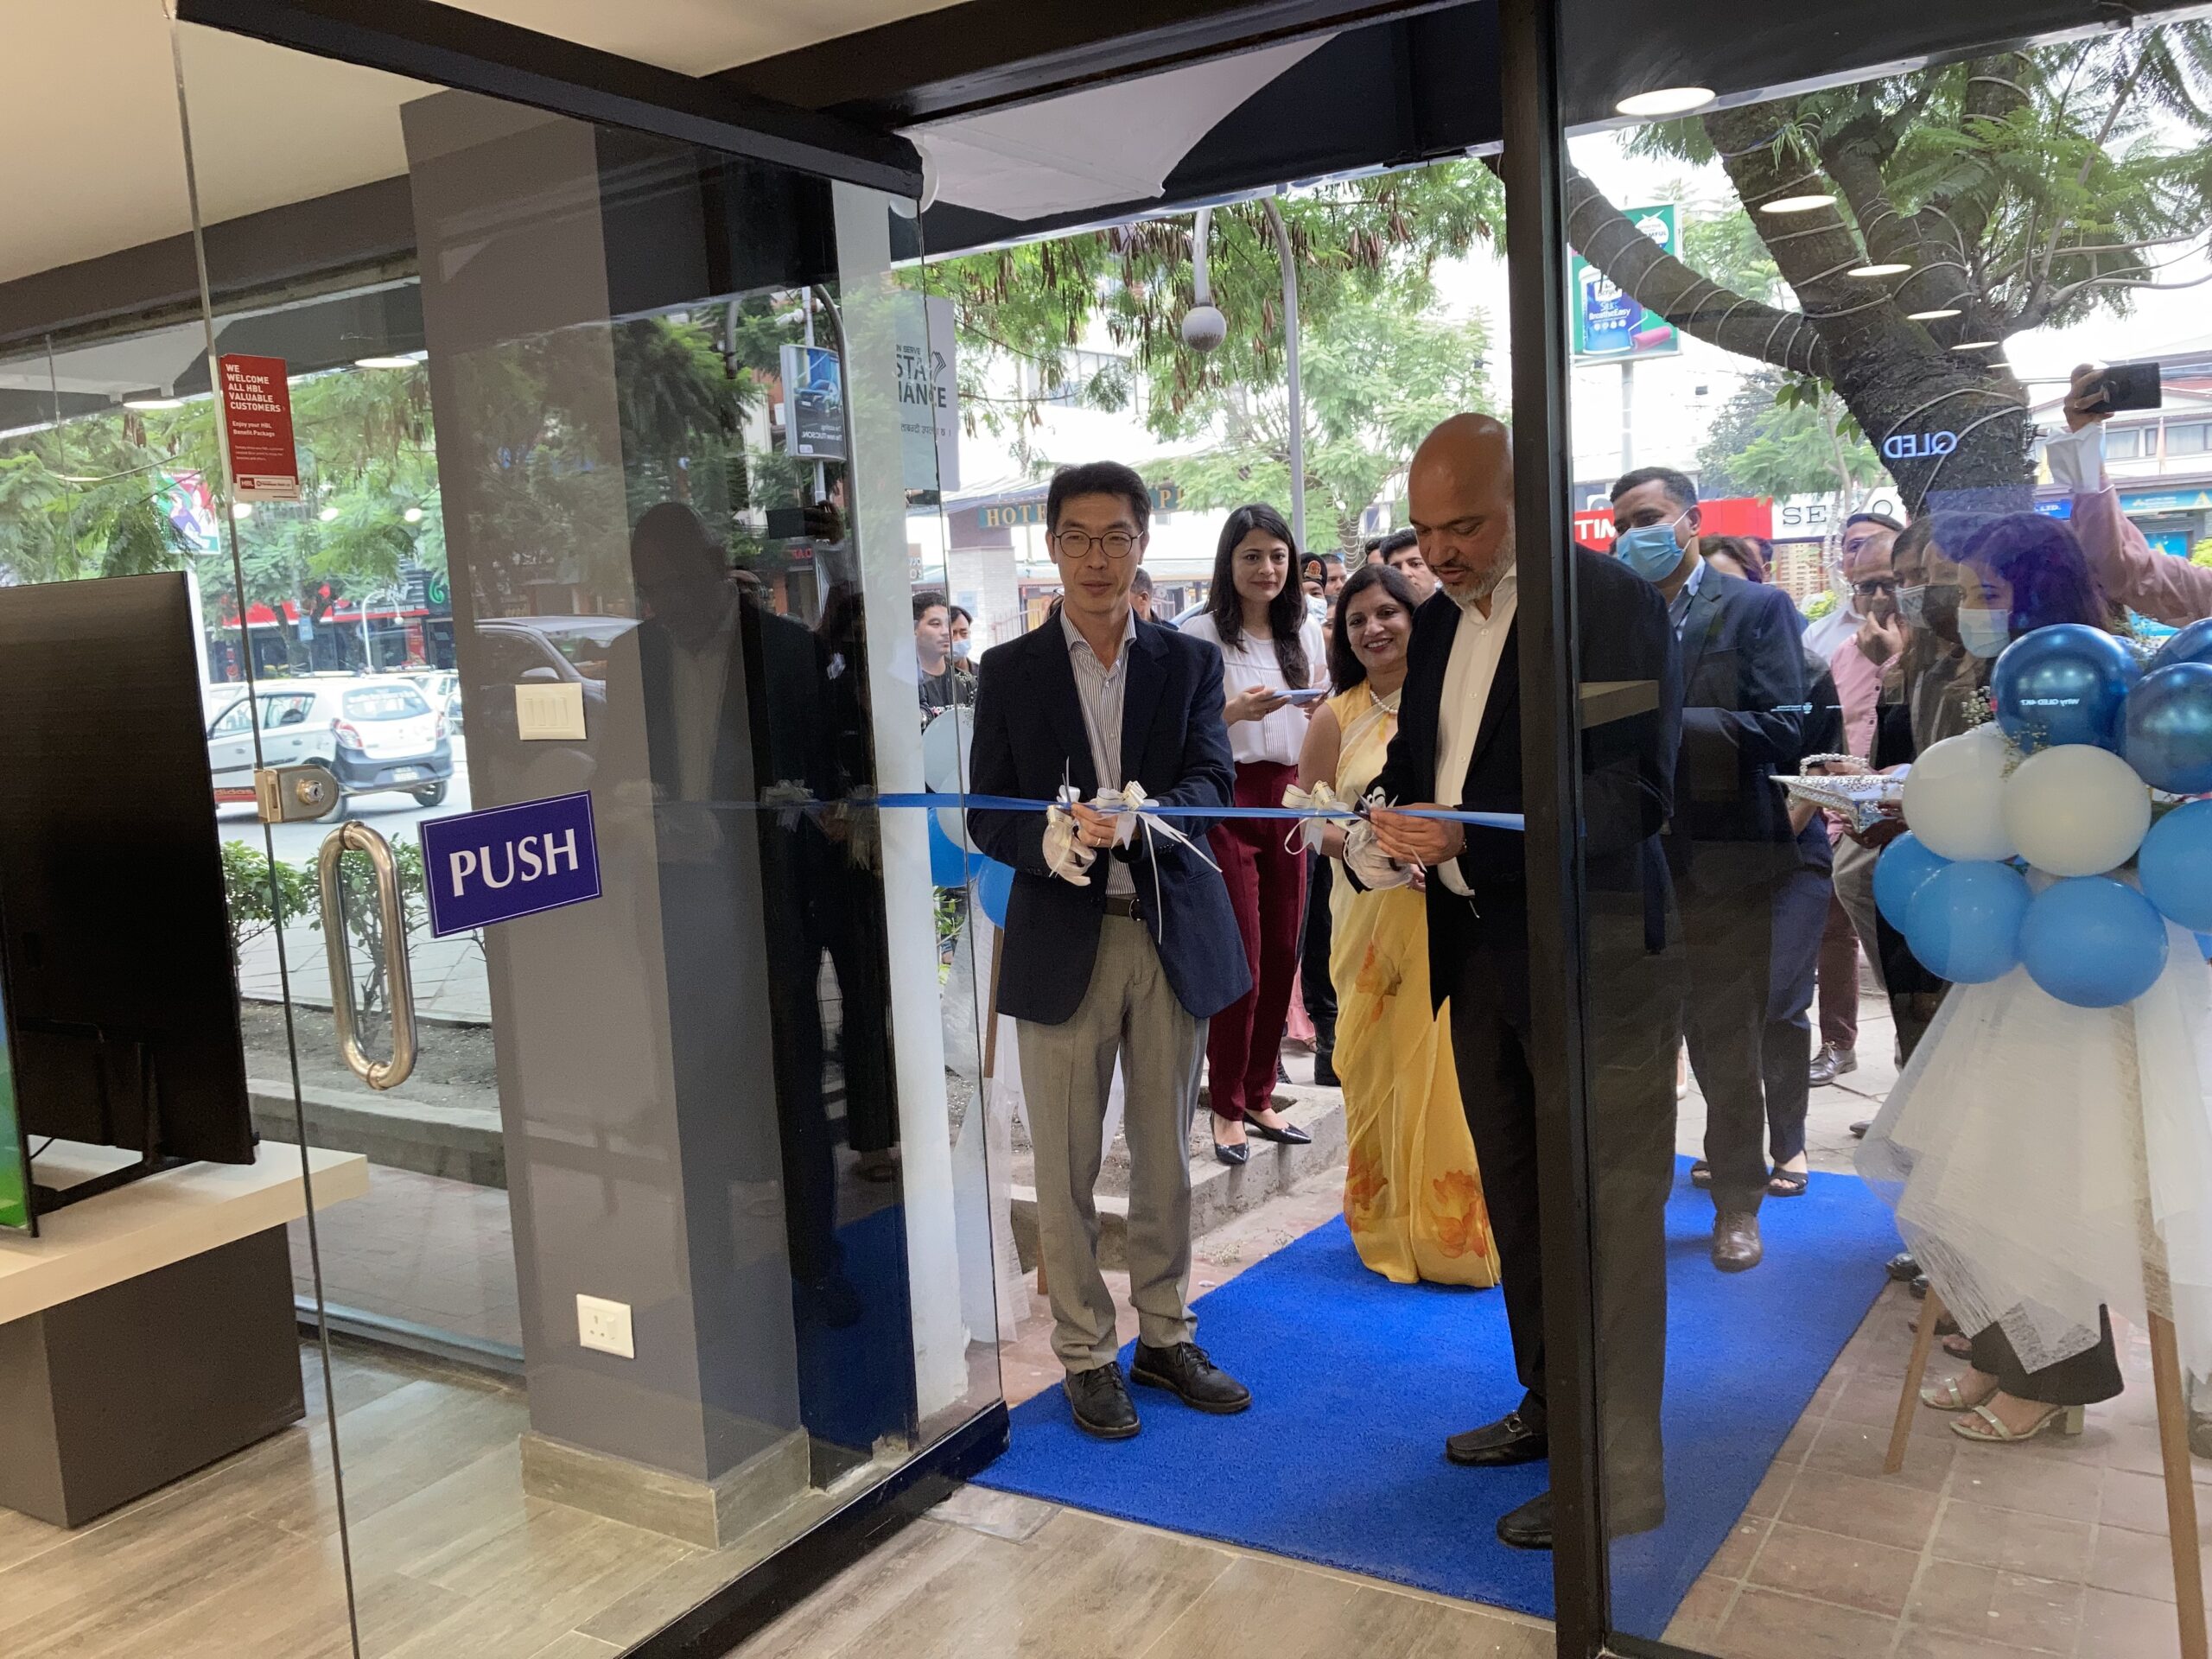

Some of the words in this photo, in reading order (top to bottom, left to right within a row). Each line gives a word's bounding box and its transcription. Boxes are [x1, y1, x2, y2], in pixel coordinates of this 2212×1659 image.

[226, 364, 240, 372] WE
[226, 373, 270, 385] WELCOME
[228, 383, 245, 391] ALL
[246, 385, 264, 393] HBL
[229, 392, 274, 403] VALUABLE
[230, 402, 282, 412] CUSTOMERS
[449, 828, 579, 898] PUSH
